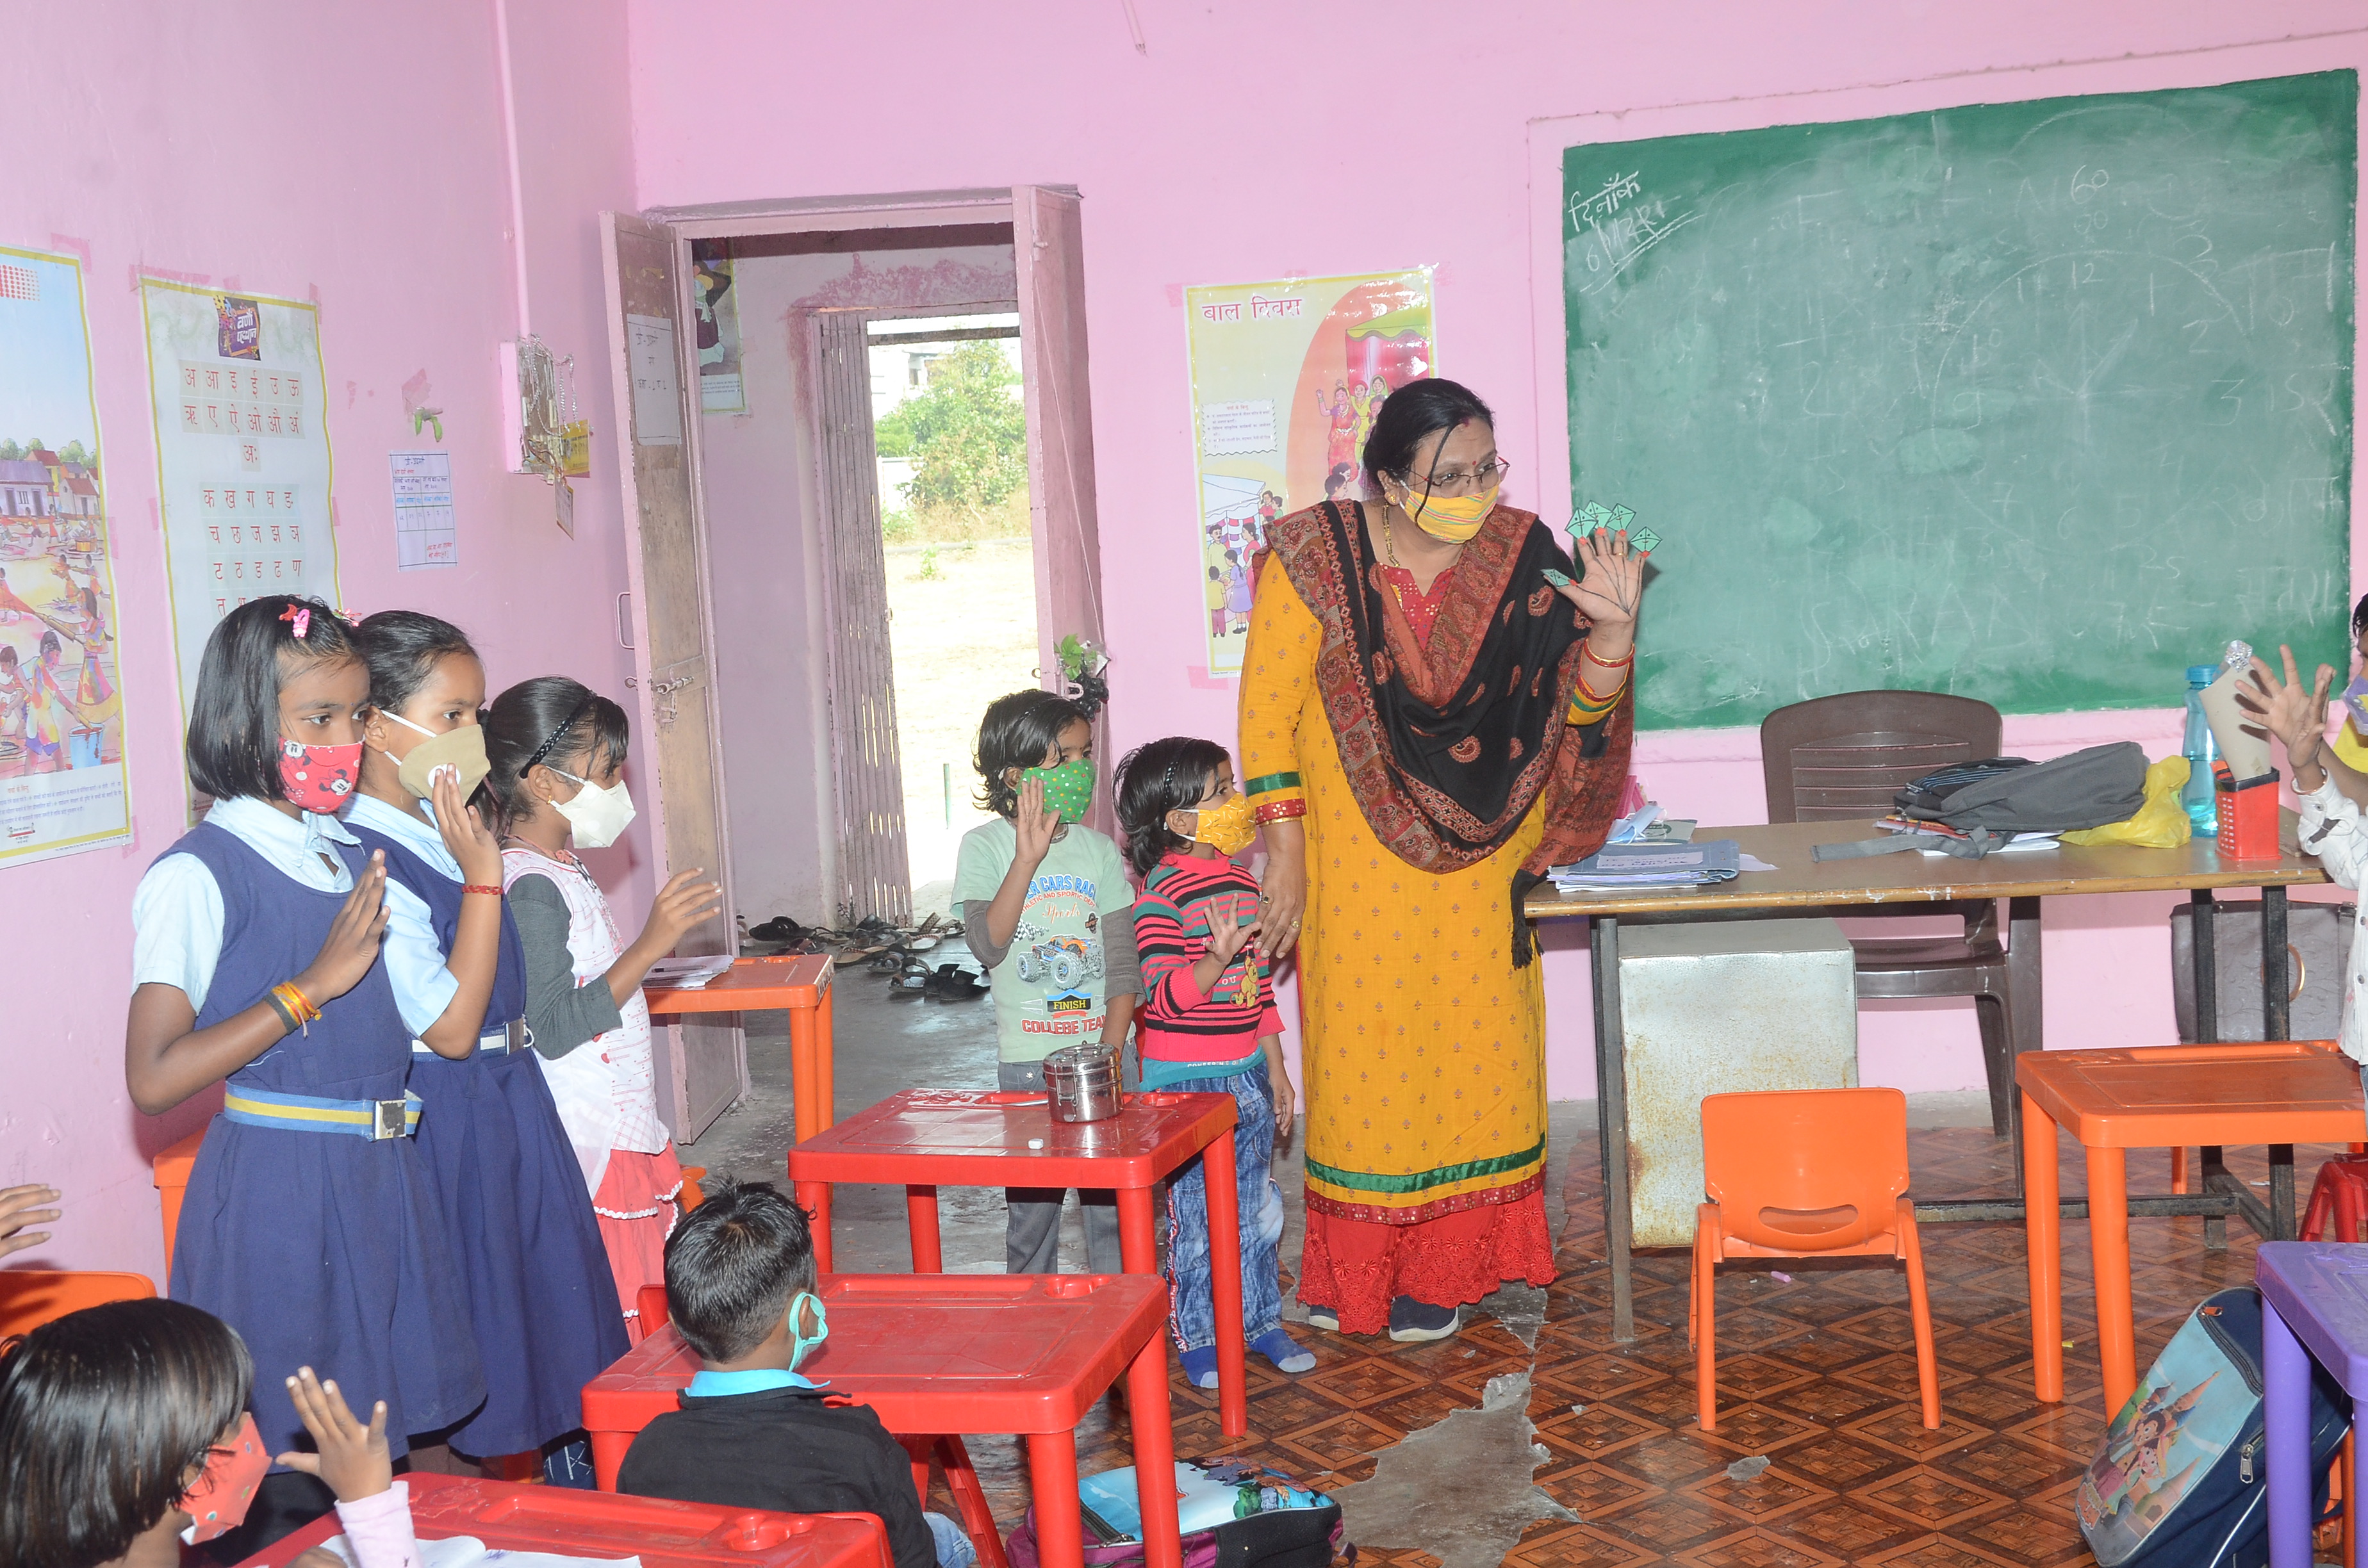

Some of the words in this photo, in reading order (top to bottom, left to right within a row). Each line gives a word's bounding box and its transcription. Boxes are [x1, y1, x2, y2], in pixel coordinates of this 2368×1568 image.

[2071, 261, 2103, 290] 12
[1202, 304, 1241, 321] बाल
[1251, 296, 1302, 318] दिवस
[185, 368, 196, 388] अ
[205, 370, 219, 389] आ
[229, 371, 237, 393] इ
[250, 370, 258, 398] ई
[269, 377, 279, 395] उ
[287, 379, 299, 396] ऊ
[184, 405, 197, 425] ऋ
[207, 405, 218, 428] ए
[228, 404, 240, 432] ऐ
[247, 407, 261, 432] ओ
[267, 408, 282, 434] औ
[289, 411, 299, 434] अं
[243, 445, 258, 463] अः
[203, 489, 215, 508] क
[224, 489, 236, 509] ख
[246, 490, 256, 508] ग
[266, 491, 275, 509] घ
[284, 492, 294, 509] ङ
[208, 525, 221, 544] च
[230, 526, 242, 544] छ
[250, 525, 262, 543] ज
[270, 525, 281, 544] झ
[288, 525, 300, 543] ञ
[213, 562, 224, 580] ट
[234, 562, 243, 579] ठ
[254, 561, 263, 579] ड
[274, 560, 283, 578] ढ
[292, 559, 302, 577] ण
[1039, 874, 1073, 892] CARS
[1074, 876, 1096, 901] RAC
[1057, 891, 1083, 901] SPORTIC
[1053, 1000, 1087, 1010] FINISH
[1021, 1020, 1080, 1035] COLLEGE
